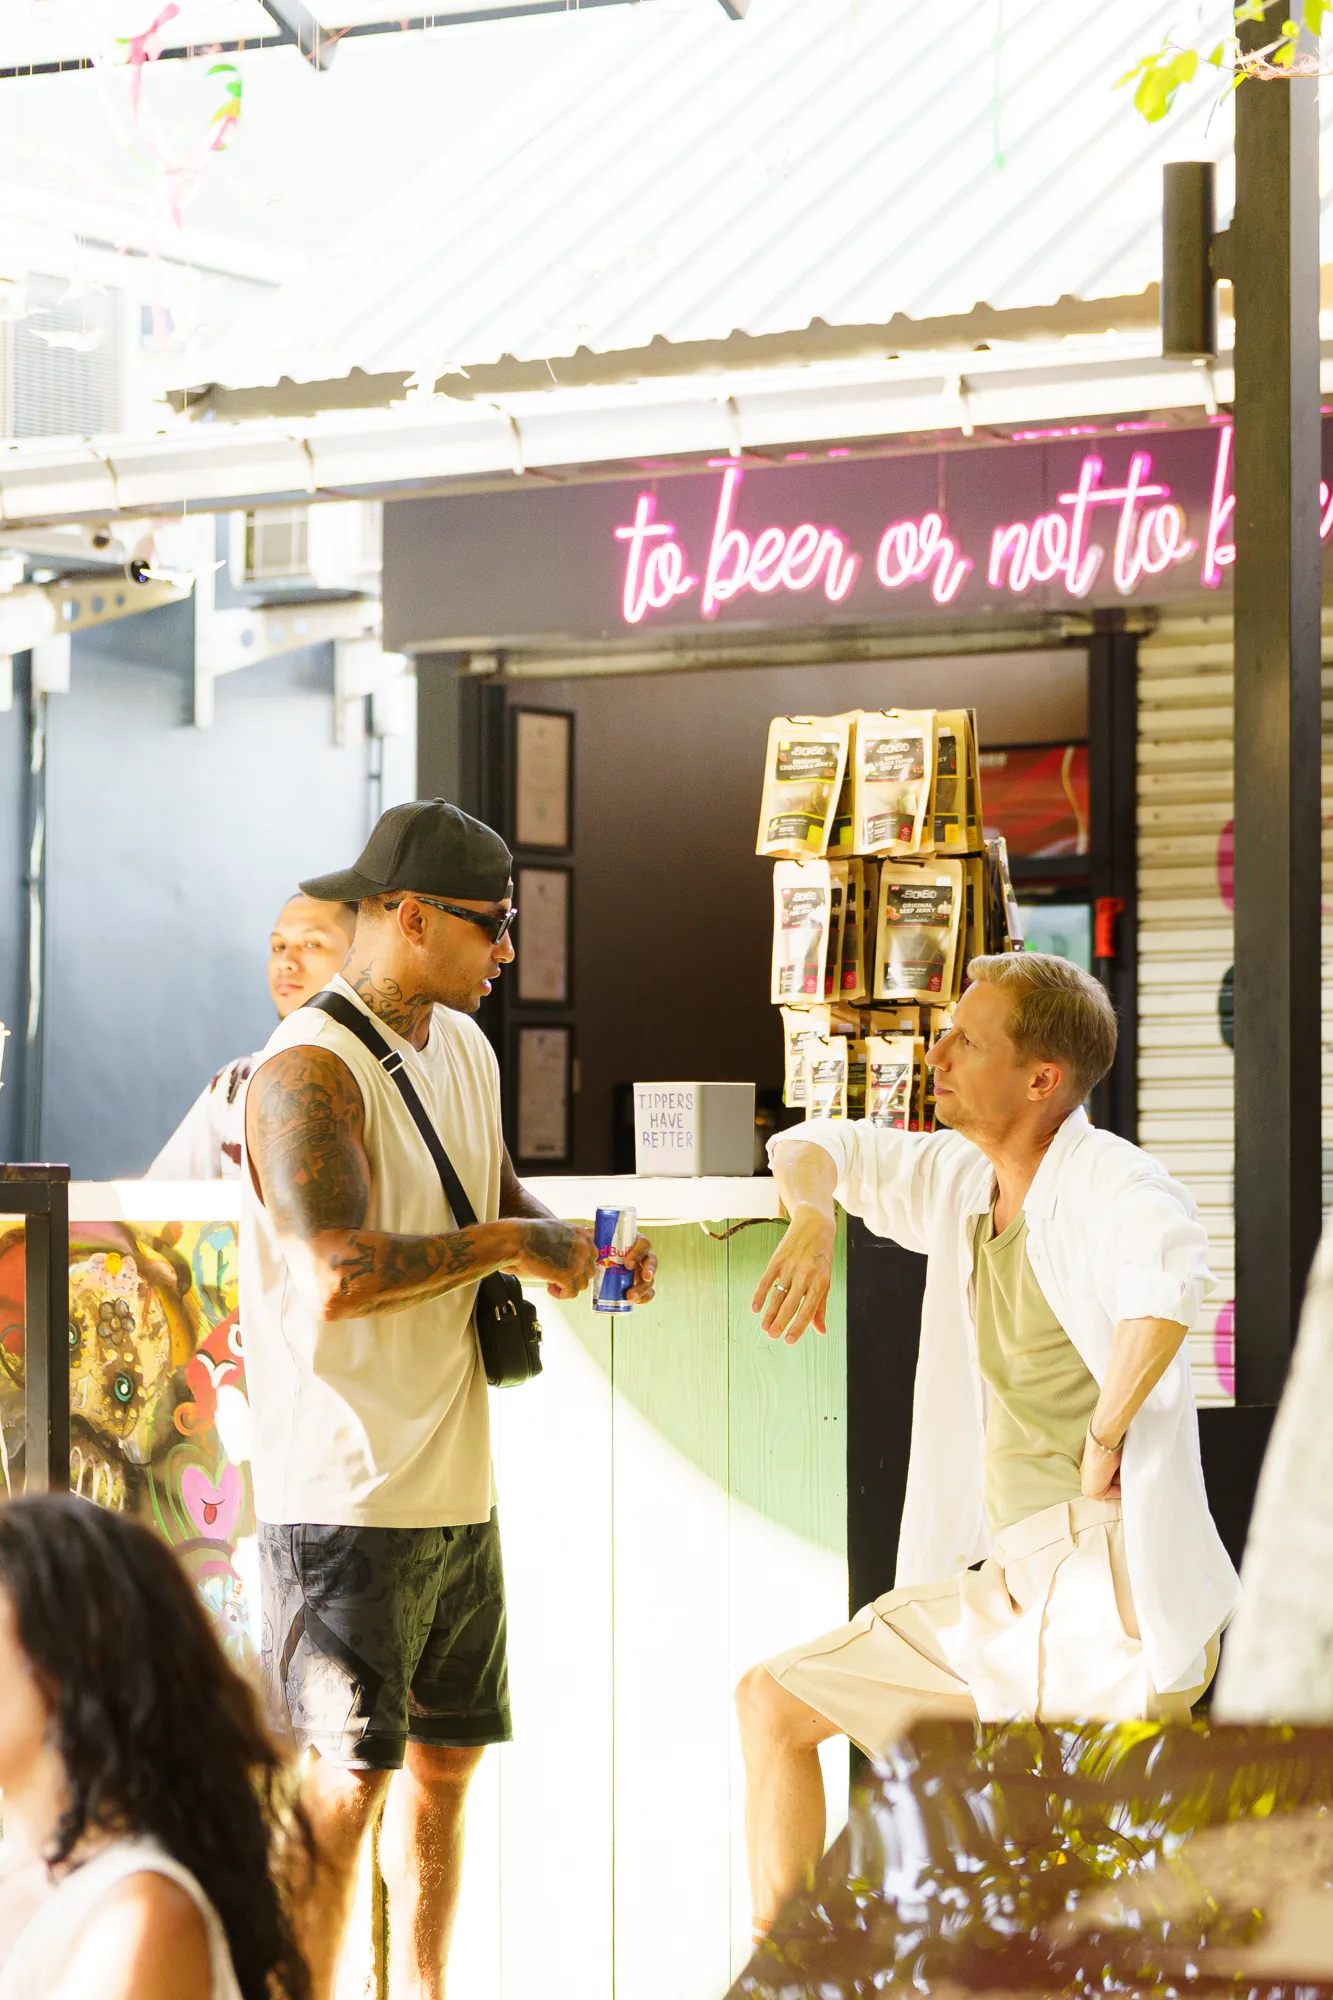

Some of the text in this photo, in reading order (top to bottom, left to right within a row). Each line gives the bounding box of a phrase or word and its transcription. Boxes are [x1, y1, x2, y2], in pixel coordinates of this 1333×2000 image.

[615, 491, 699, 624] to
[701, 465, 861, 619] beer
[877, 511, 972, 604] or
[988, 454, 1105, 597] not
[1109, 451, 1199, 595] to
[638, 1093, 694, 1110] TIPPERS
[650, 1112, 684, 1129] HAVE
[642, 1131, 693, 1148] BETTER
